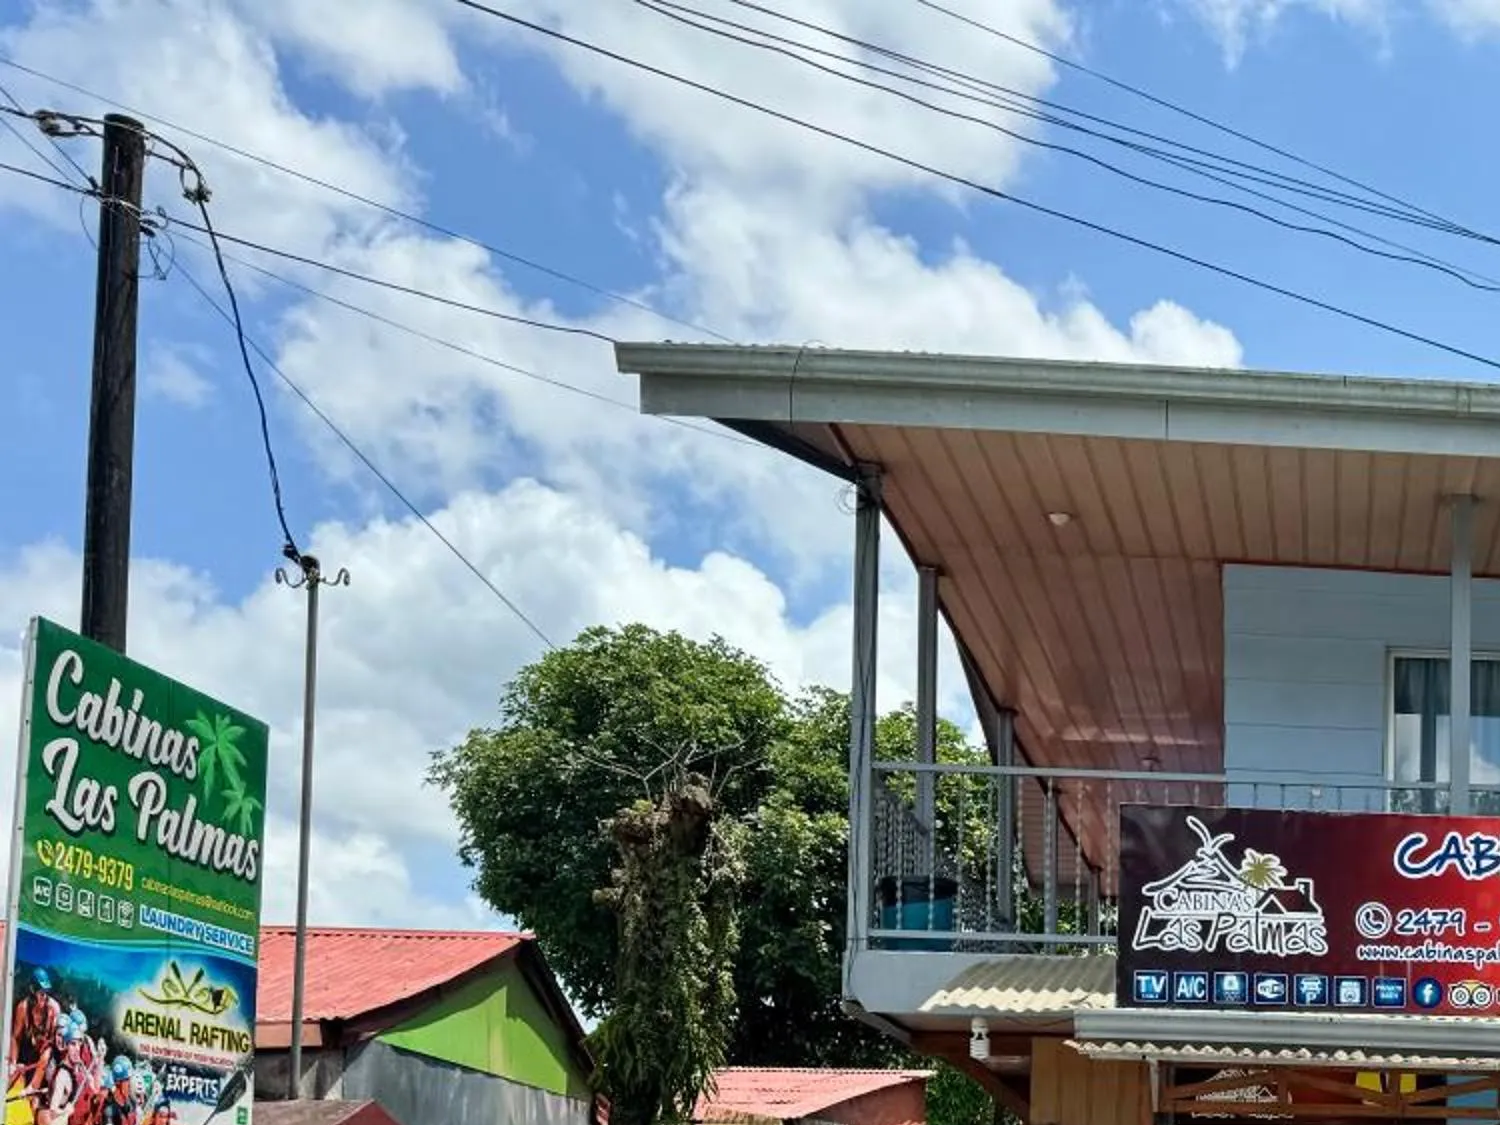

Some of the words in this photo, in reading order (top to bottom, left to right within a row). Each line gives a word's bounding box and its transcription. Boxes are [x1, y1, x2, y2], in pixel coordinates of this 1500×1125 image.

[45, 648, 199, 781] Cabinas
[42, 737, 119, 833] Las
[127, 770, 260, 882] Palmas
[55, 841, 134, 891] 2479-9379
[1154, 887, 1255, 913] CABINAS
[1395, 908, 1466, 936] 2479
[140, 903, 202, 940] LAUNDRY
[203, 923, 254, 955] SERVICE
[1133, 906, 1203, 951] Las
[1205, 911, 1329, 957] Palmas
[1137, 975, 1166, 993] TV
[1177, 977, 1206, 998] A/C
[121, 1008, 186, 1043] ARENAL
[189, 1021, 251, 1053] RAFTING
[166, 1072, 219, 1099] EXPERTS
